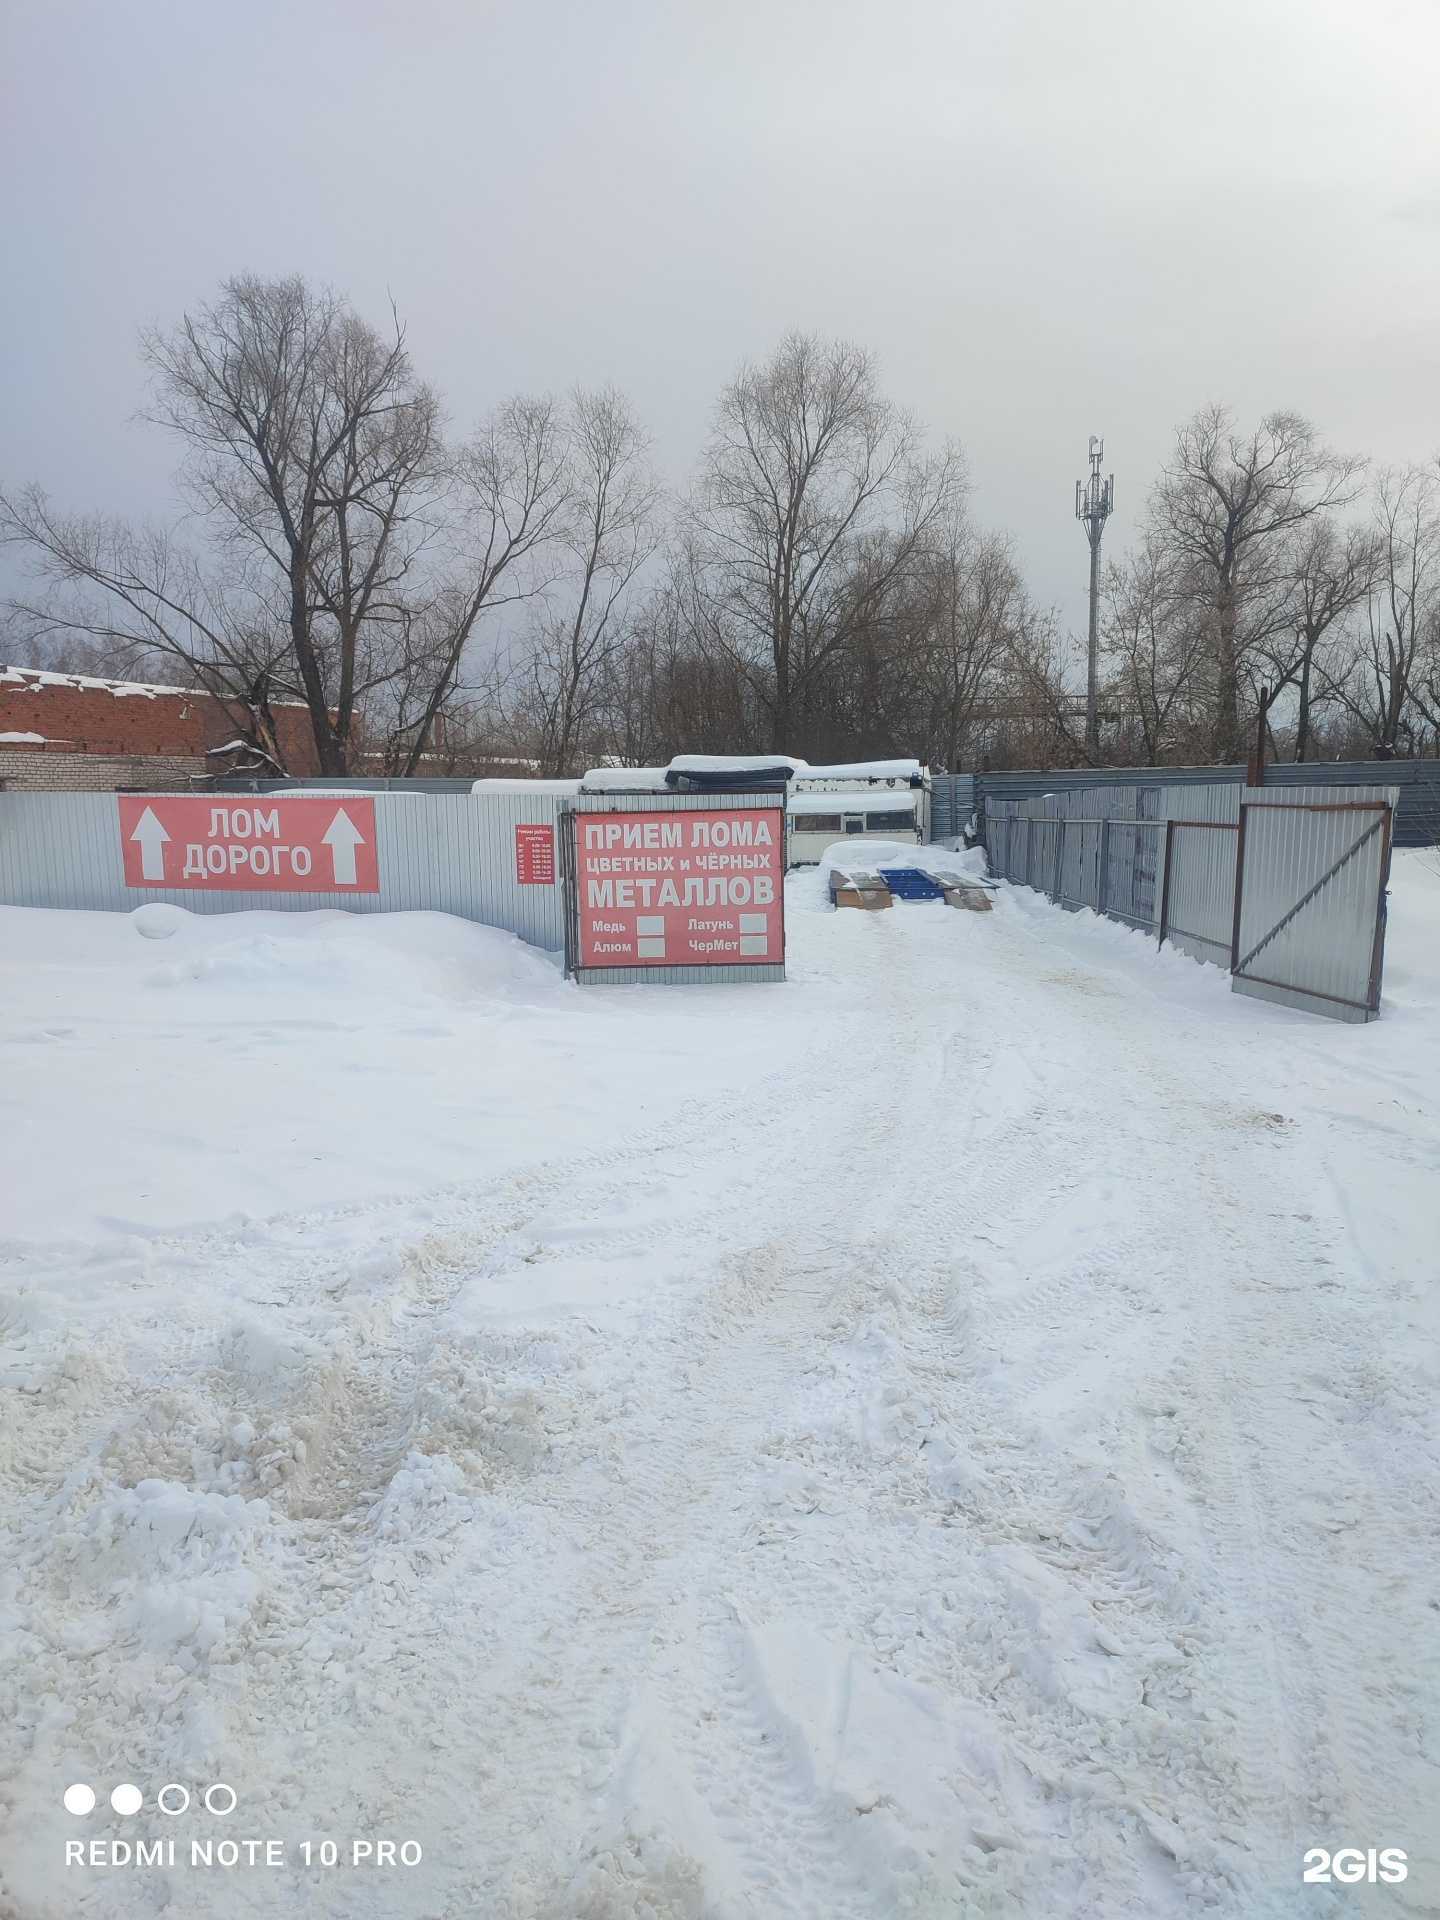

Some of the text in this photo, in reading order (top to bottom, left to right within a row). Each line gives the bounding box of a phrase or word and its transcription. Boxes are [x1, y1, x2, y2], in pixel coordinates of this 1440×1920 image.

[207, 808, 281, 839] ЛОМ
[585, 820, 773, 850] ПРИЕМ ЛОМА
[183, 844, 312, 880] ДОРОГО
[586, 852, 771, 875] ЦВЕТНЫХ и ЧЁРНЫХ
[587, 875, 774, 909] МЕТАЛЛОВ
[592, 920, 626, 934] Медь
[687, 918, 734, 932] Латунь
[593, 941, 632, 953] Алюм
[688, 939, 739, 953] ЧерМет
